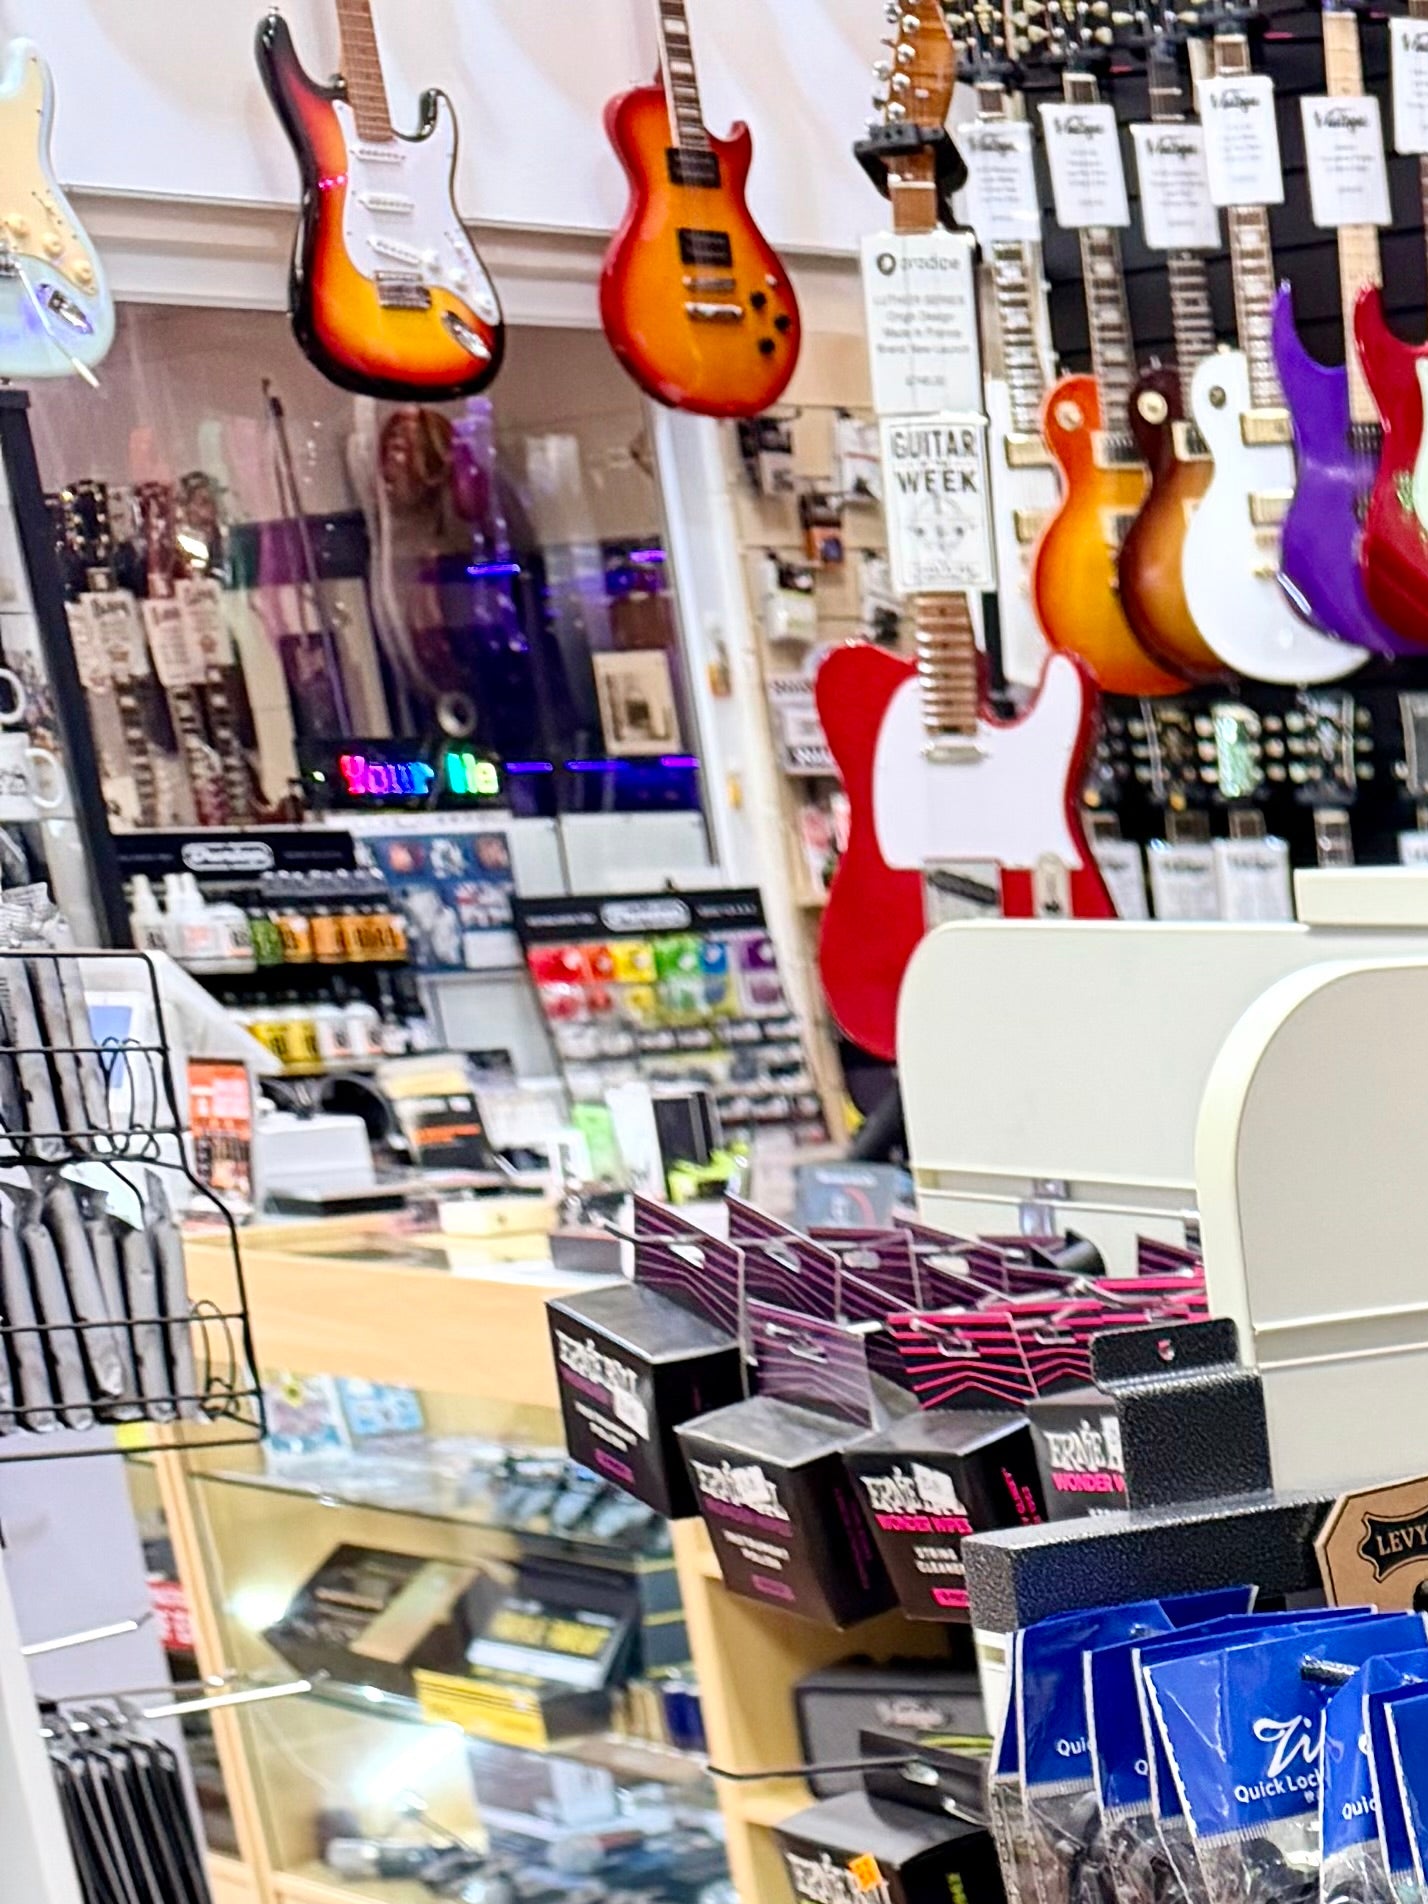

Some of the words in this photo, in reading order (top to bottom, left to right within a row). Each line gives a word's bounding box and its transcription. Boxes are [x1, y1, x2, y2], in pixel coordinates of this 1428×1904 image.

[891, 430, 978, 459] GUITAR
[894, 470, 978, 493] WEEK
[1052, 1472, 1113, 1493] WONDER
[1234, 1778, 1287, 1804] Quick
